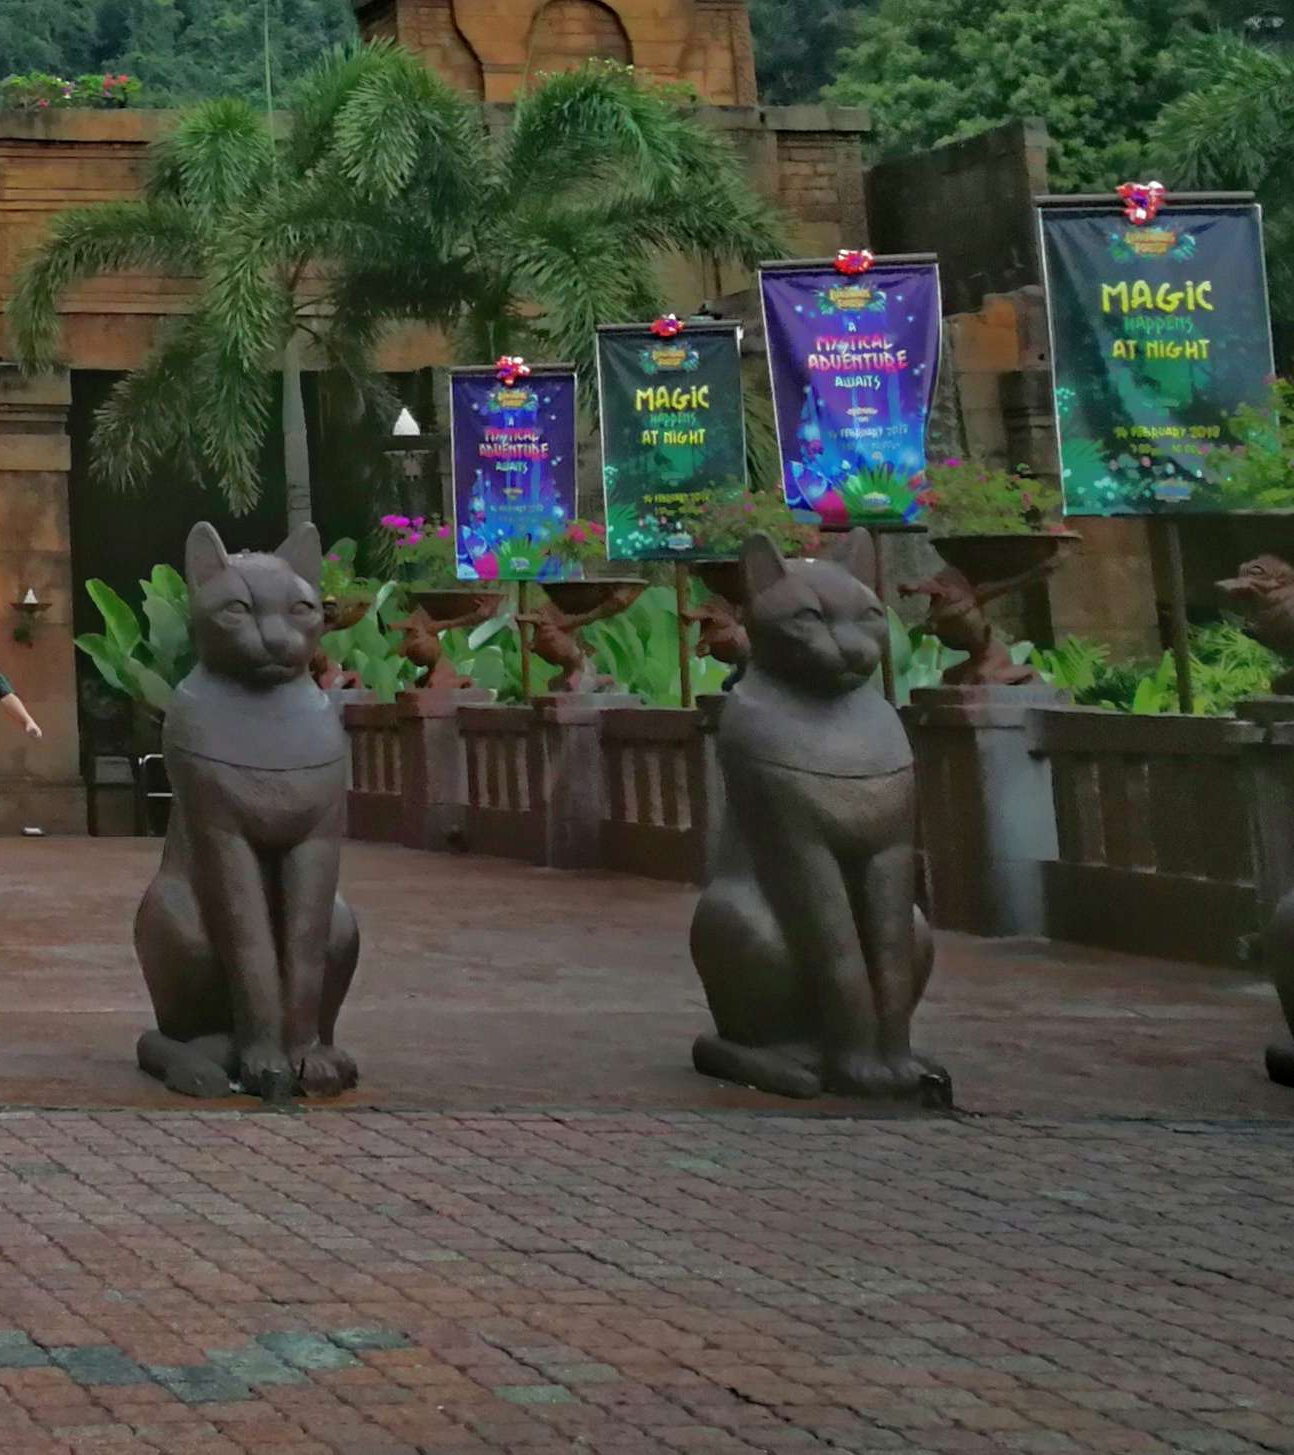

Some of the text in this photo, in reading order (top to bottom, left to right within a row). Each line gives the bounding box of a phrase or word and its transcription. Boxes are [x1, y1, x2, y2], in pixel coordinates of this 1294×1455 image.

[1112, 339, 1211, 360] AT NIGHT
[642, 428, 706, 446] AT NIGHT
